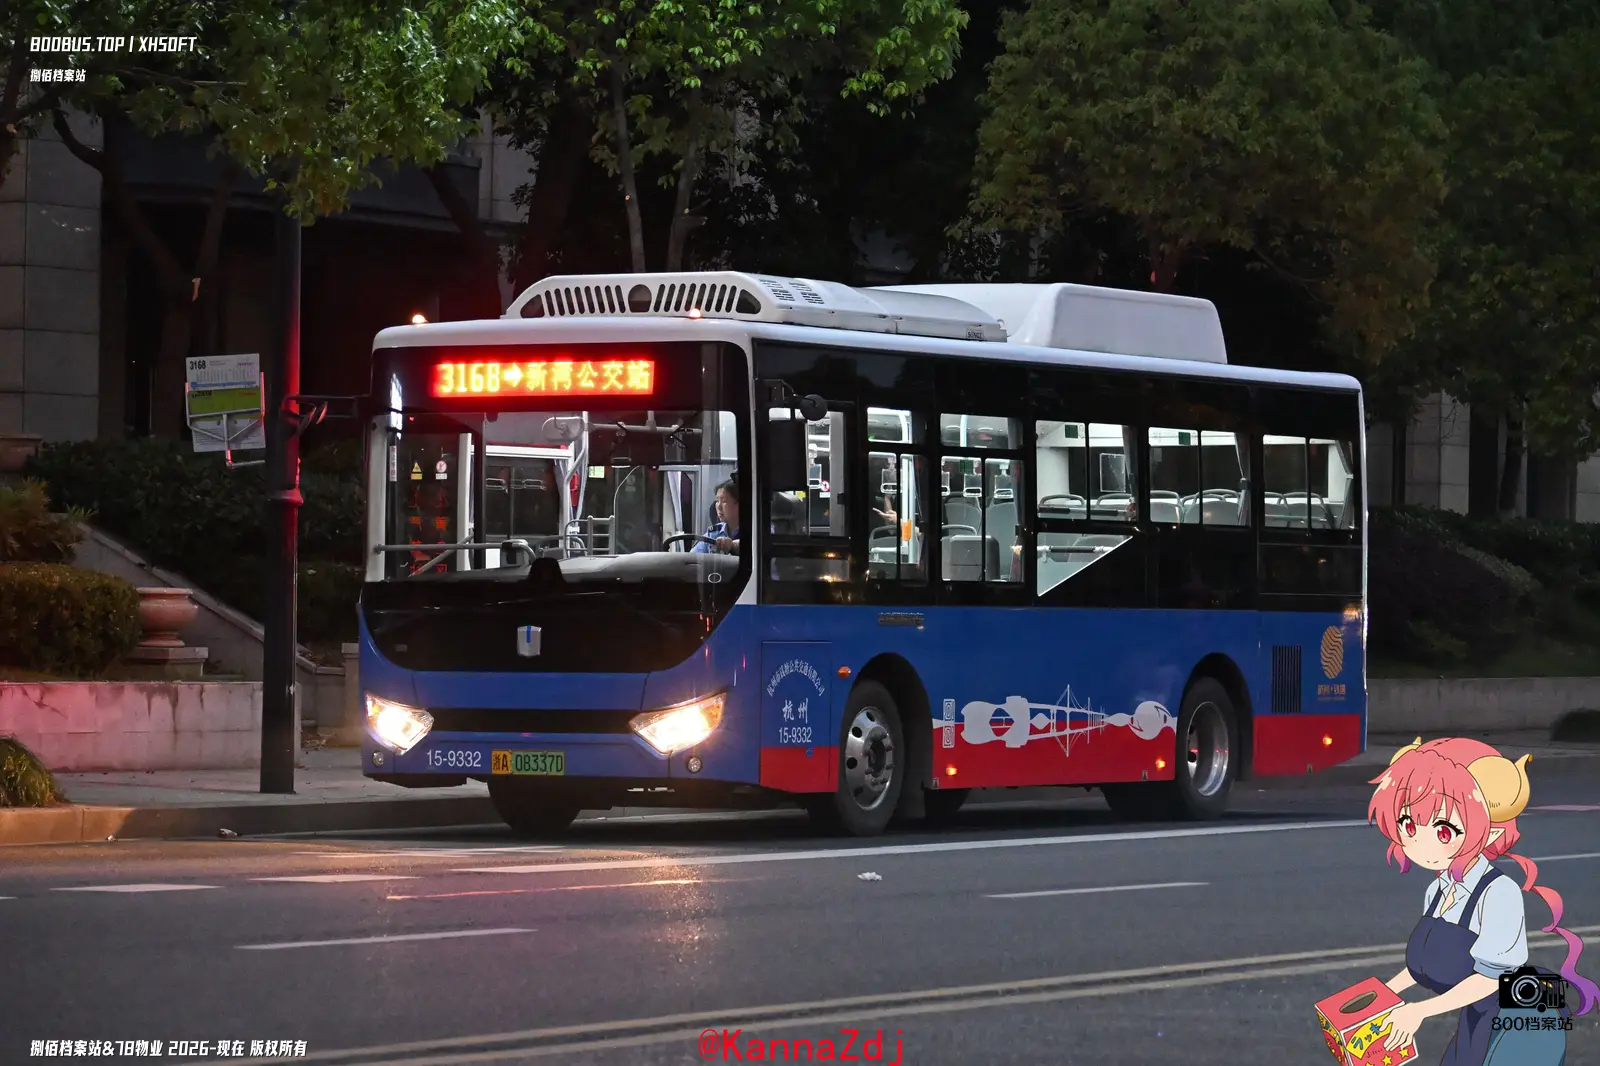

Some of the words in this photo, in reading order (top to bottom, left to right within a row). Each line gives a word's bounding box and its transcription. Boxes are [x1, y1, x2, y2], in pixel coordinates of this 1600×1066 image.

[189, 360, 207, 370] 3168
[438, 362, 500, 393] 3168
[782, 697, 809, 724] 杭州
[778, 726, 812, 744] 15-9332
[426, 749, 482, 767] 15-9332
